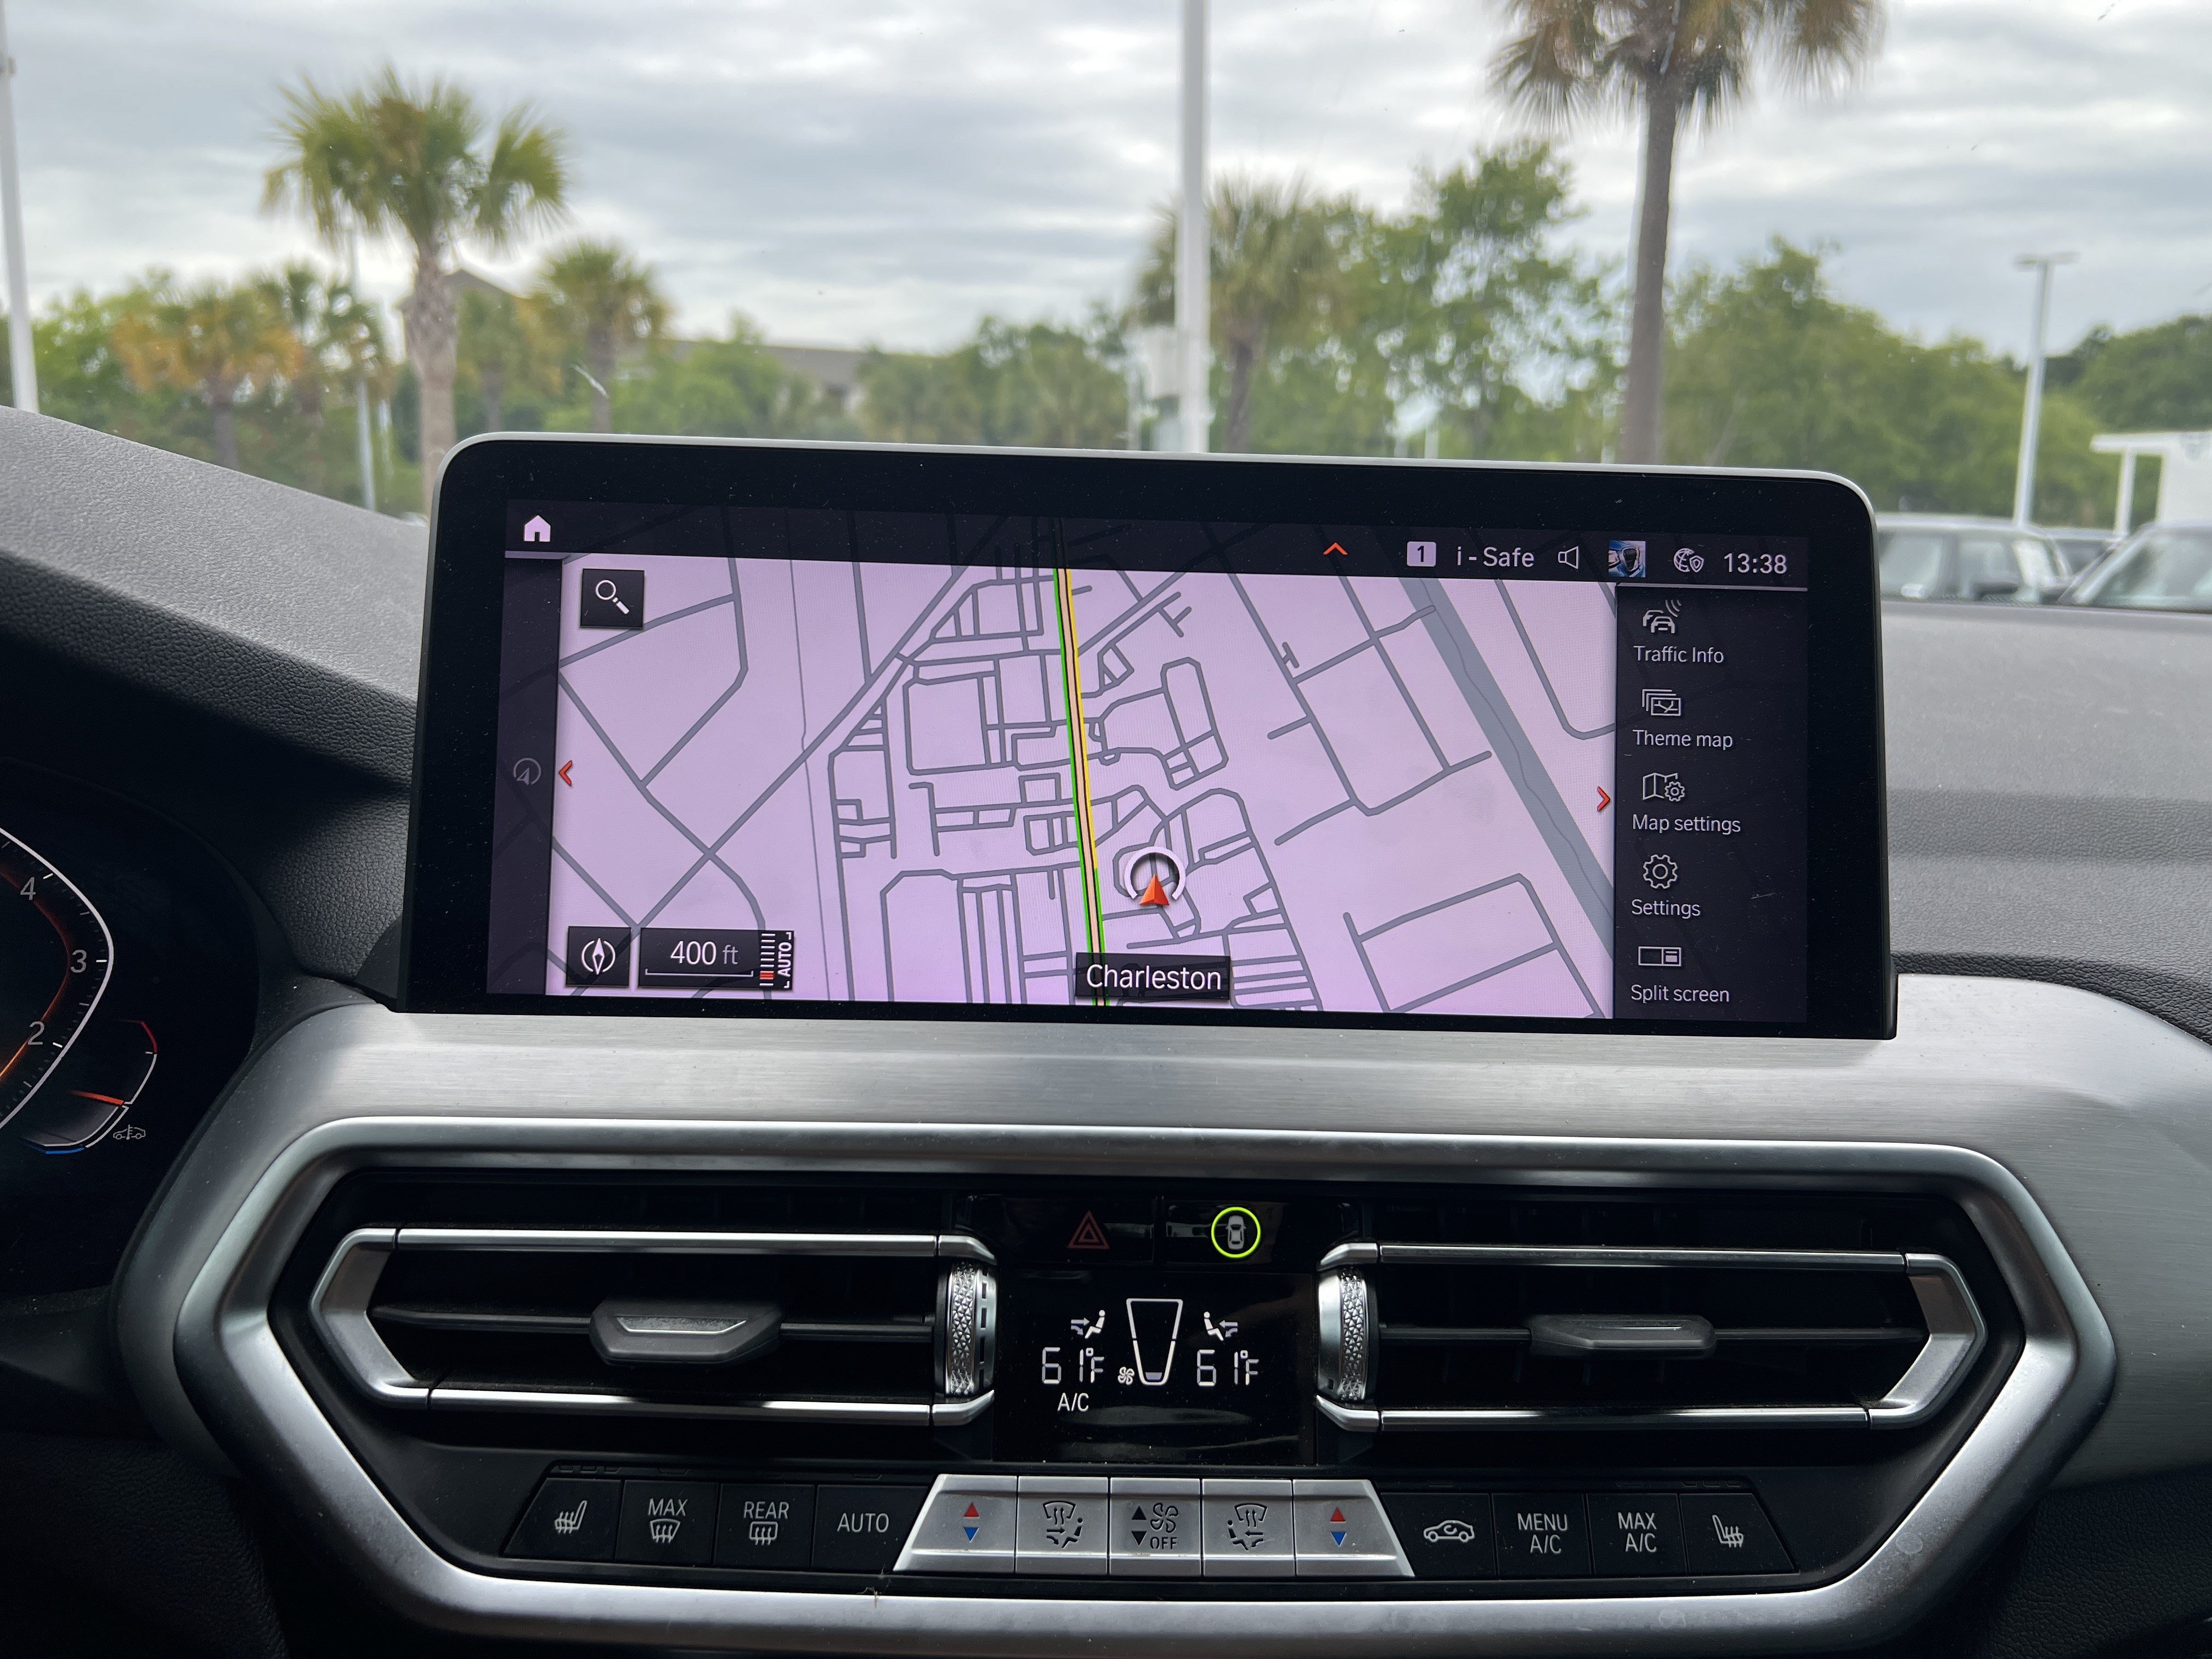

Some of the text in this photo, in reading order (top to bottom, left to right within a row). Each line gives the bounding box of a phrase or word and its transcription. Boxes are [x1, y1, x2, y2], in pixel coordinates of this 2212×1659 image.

[1724, 553, 1787, 574] 13:38
[1633, 645, 1725, 664] Traffic Info
[1632, 729, 1734, 751] Theme map
[1633, 814, 1741, 835] Map settings
[20, 877, 36, 900] 4
[1631, 899, 1701, 919] Settings
[70, 949, 87, 973] 3
[670, 940, 738, 965] 400 ft
[777, 942, 792, 977] AUTO
[1086, 964, 1221, 990] Charleston
[1631, 984, 1729, 1003] Split screen
[27, 1021, 44, 1045] 2
[1057, 1392, 1090, 1412] A/C
[648, 1498, 689, 1517] MAX
[743, 1501, 789, 1520] REAR
[837, 1513, 890, 1533] AUTO
[1517, 1513, 1568, 1531] MENU
[1618, 1512, 1657, 1530] MAX
[1150, 1536, 1177, 1550] OFF
[1530, 1534, 1561, 1554] A/C
[1625, 1532, 1657, 1553] A/C
